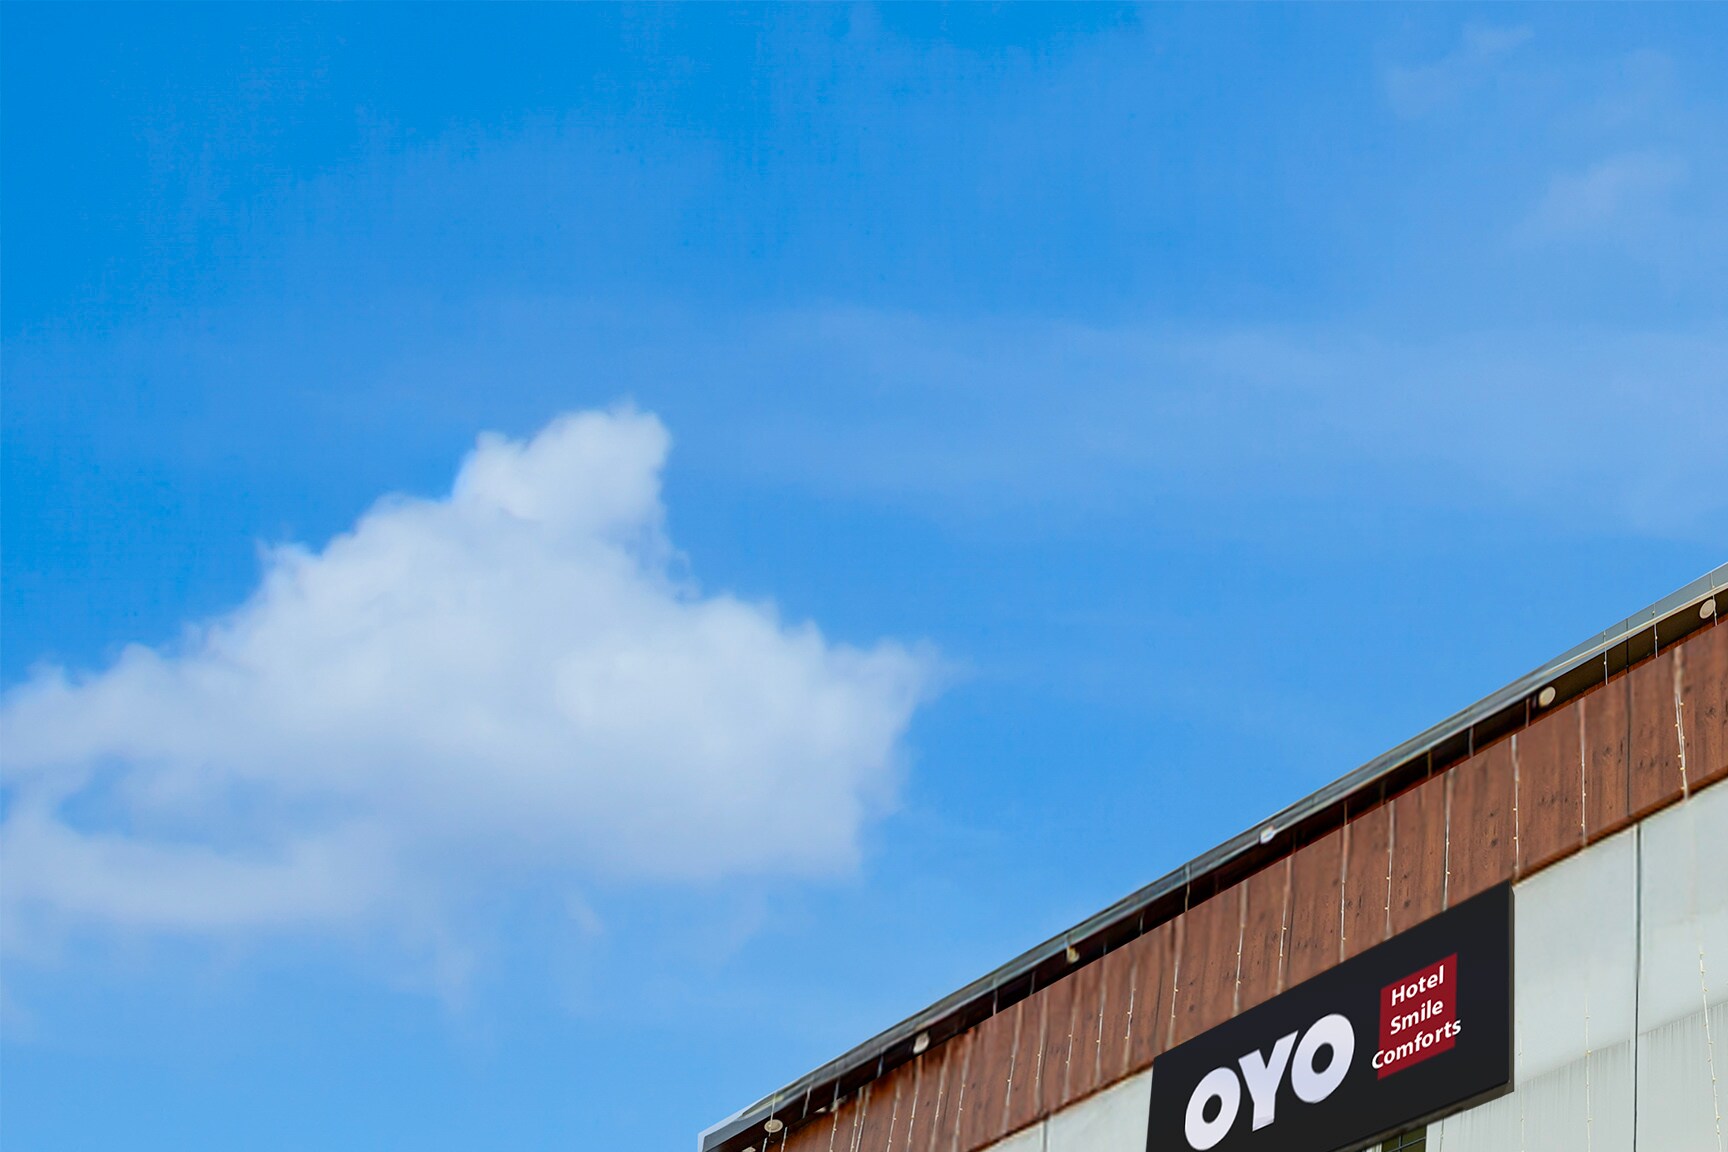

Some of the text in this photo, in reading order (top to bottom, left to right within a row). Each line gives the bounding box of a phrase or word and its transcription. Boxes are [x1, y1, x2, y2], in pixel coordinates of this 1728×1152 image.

[1391, 964, 1445, 1007] Hotel
[1389, 999, 1445, 1036] Smile
[1371, 1018, 1462, 1070] Comforts
[1184, 1013, 1356, 1152] OYO
